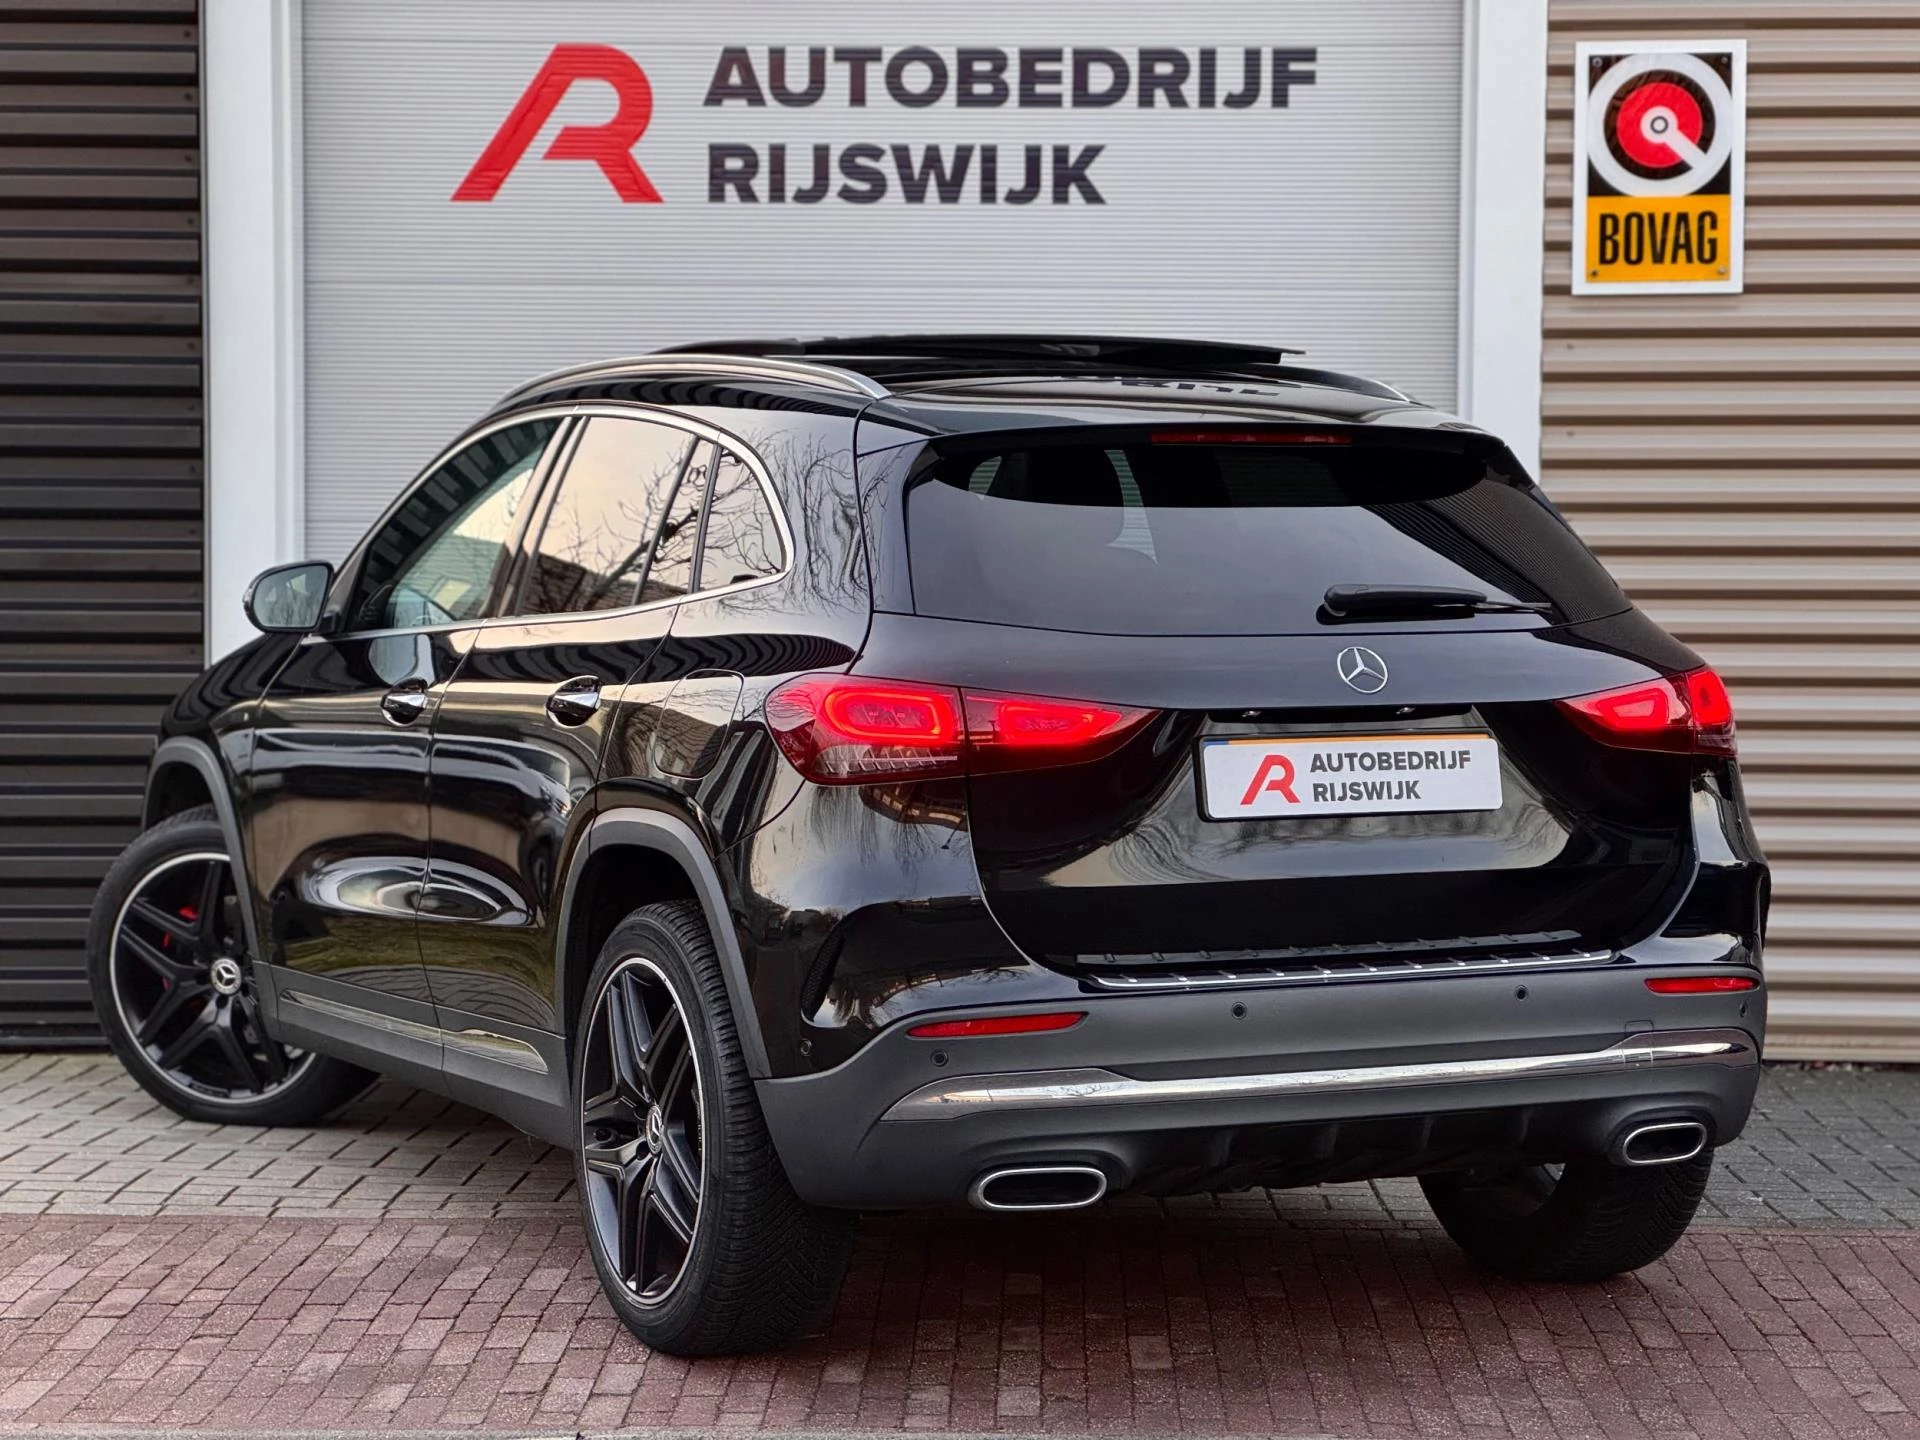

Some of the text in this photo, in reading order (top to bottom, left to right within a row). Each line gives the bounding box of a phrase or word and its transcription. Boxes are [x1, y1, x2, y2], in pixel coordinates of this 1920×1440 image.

[704, 46, 1317, 108] AUTOBEDRIJF
[708, 144, 1106, 204] RIJSWIJK
[1598, 211, 1719, 266] BOVAG
[1310, 750, 1471, 773] AUTOBEDRIJF
[1313, 780, 1421, 802] RIJSWIJK
